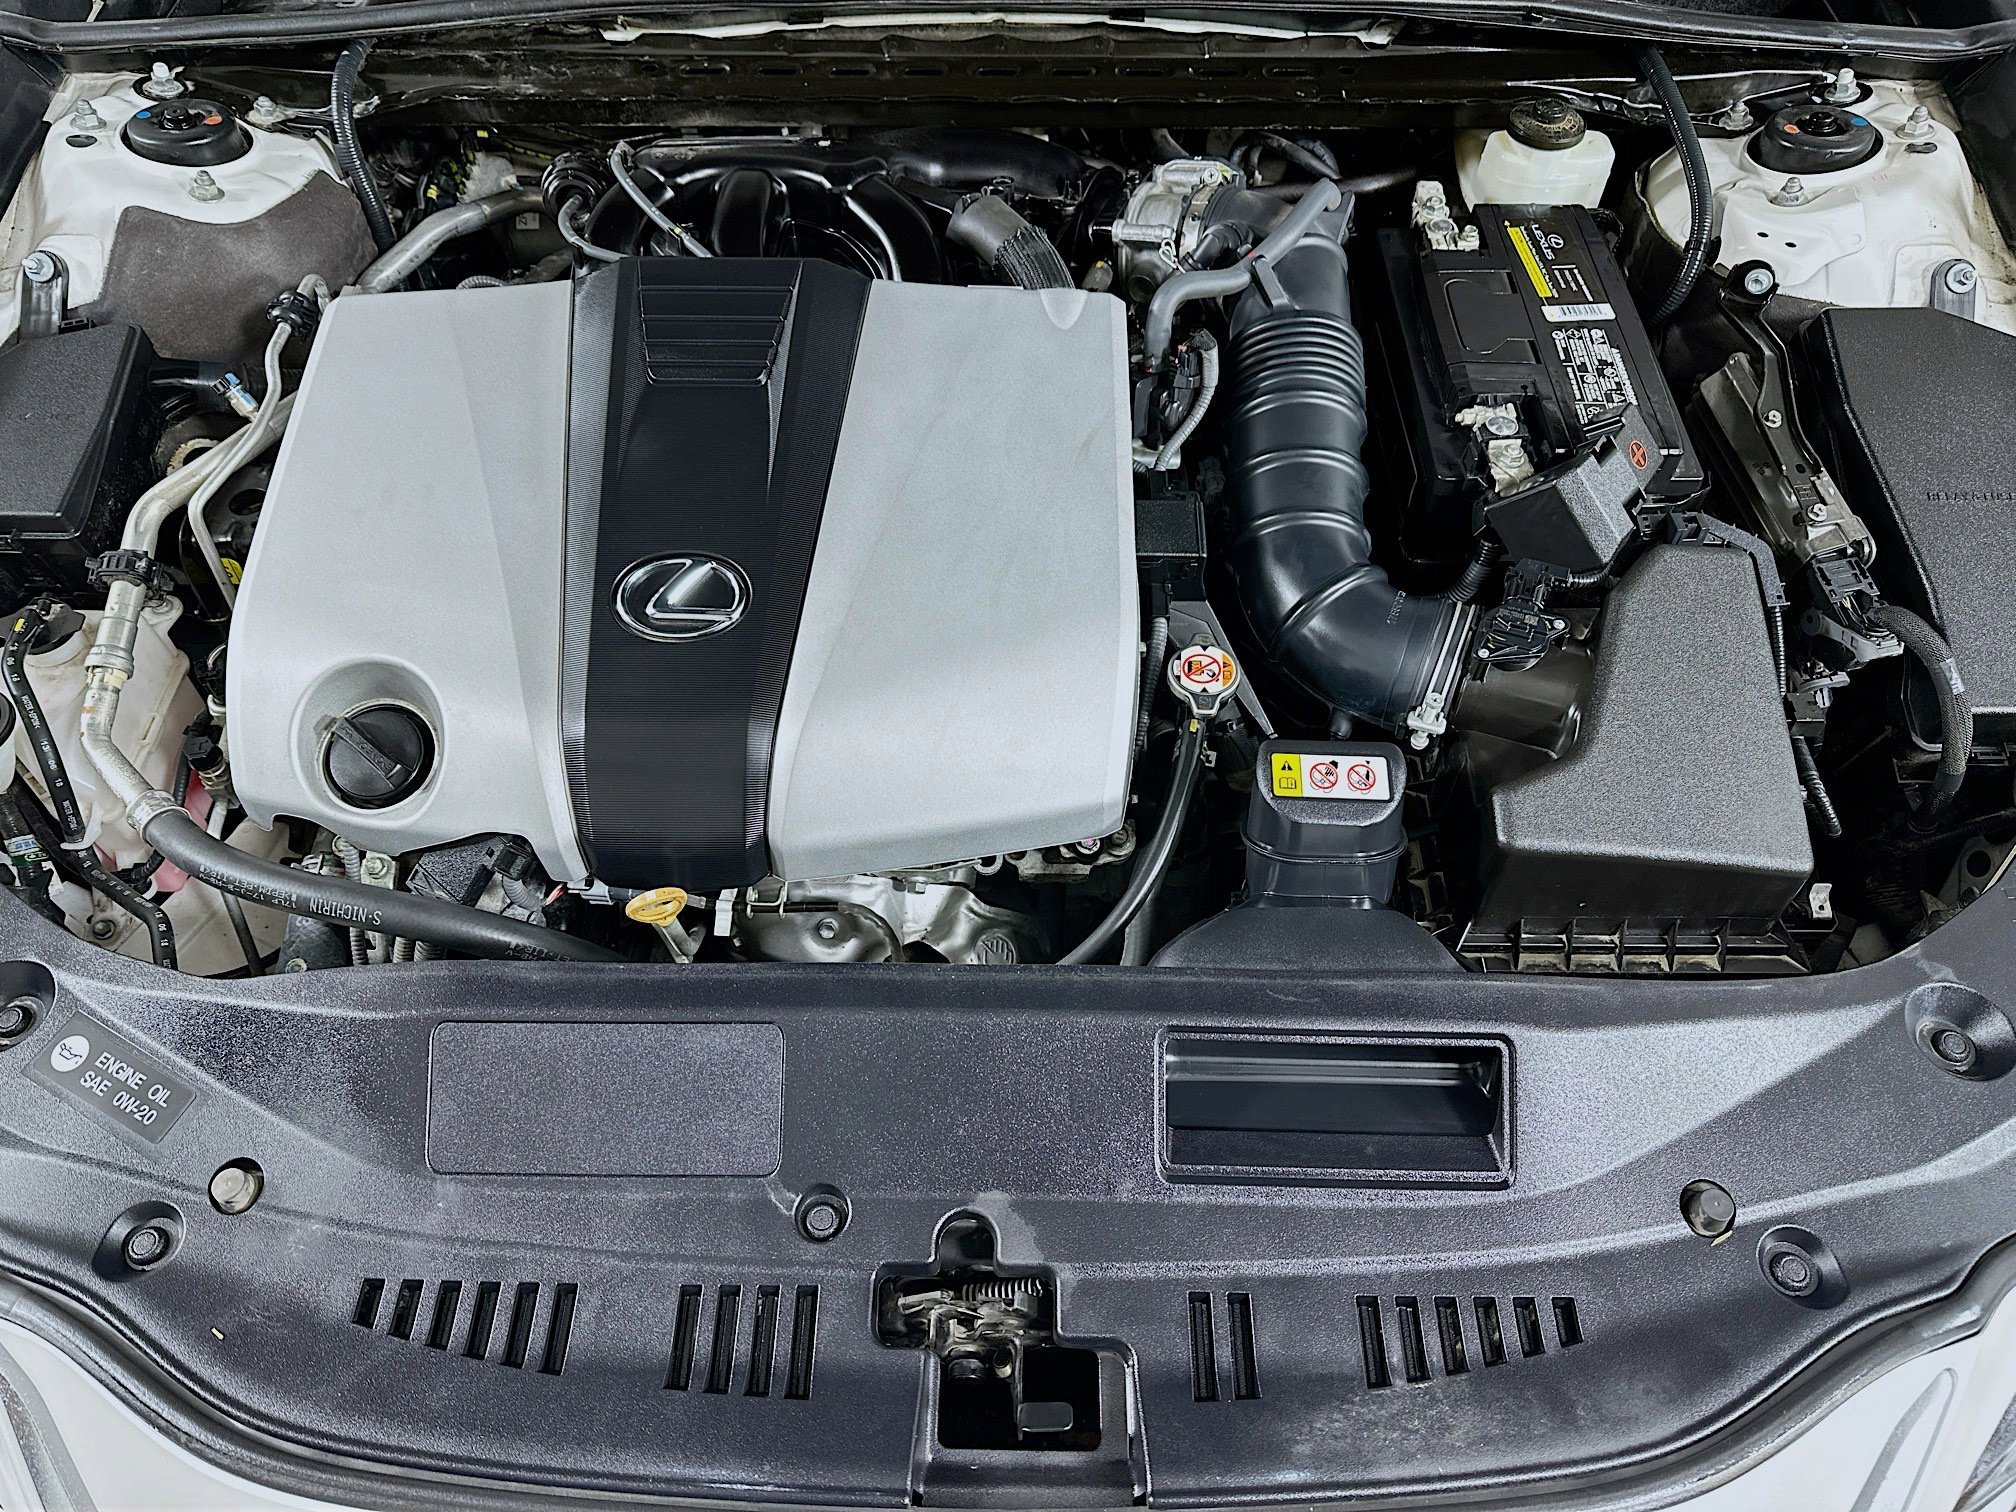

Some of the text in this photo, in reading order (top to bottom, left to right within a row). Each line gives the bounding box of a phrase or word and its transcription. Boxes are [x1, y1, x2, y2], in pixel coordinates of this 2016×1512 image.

[1532, 224, 1555, 260] LEXUS
[80, 1070, 158, 1126] SAE 0W-20
[94, 1051, 171, 1108] ENGINE OIL
